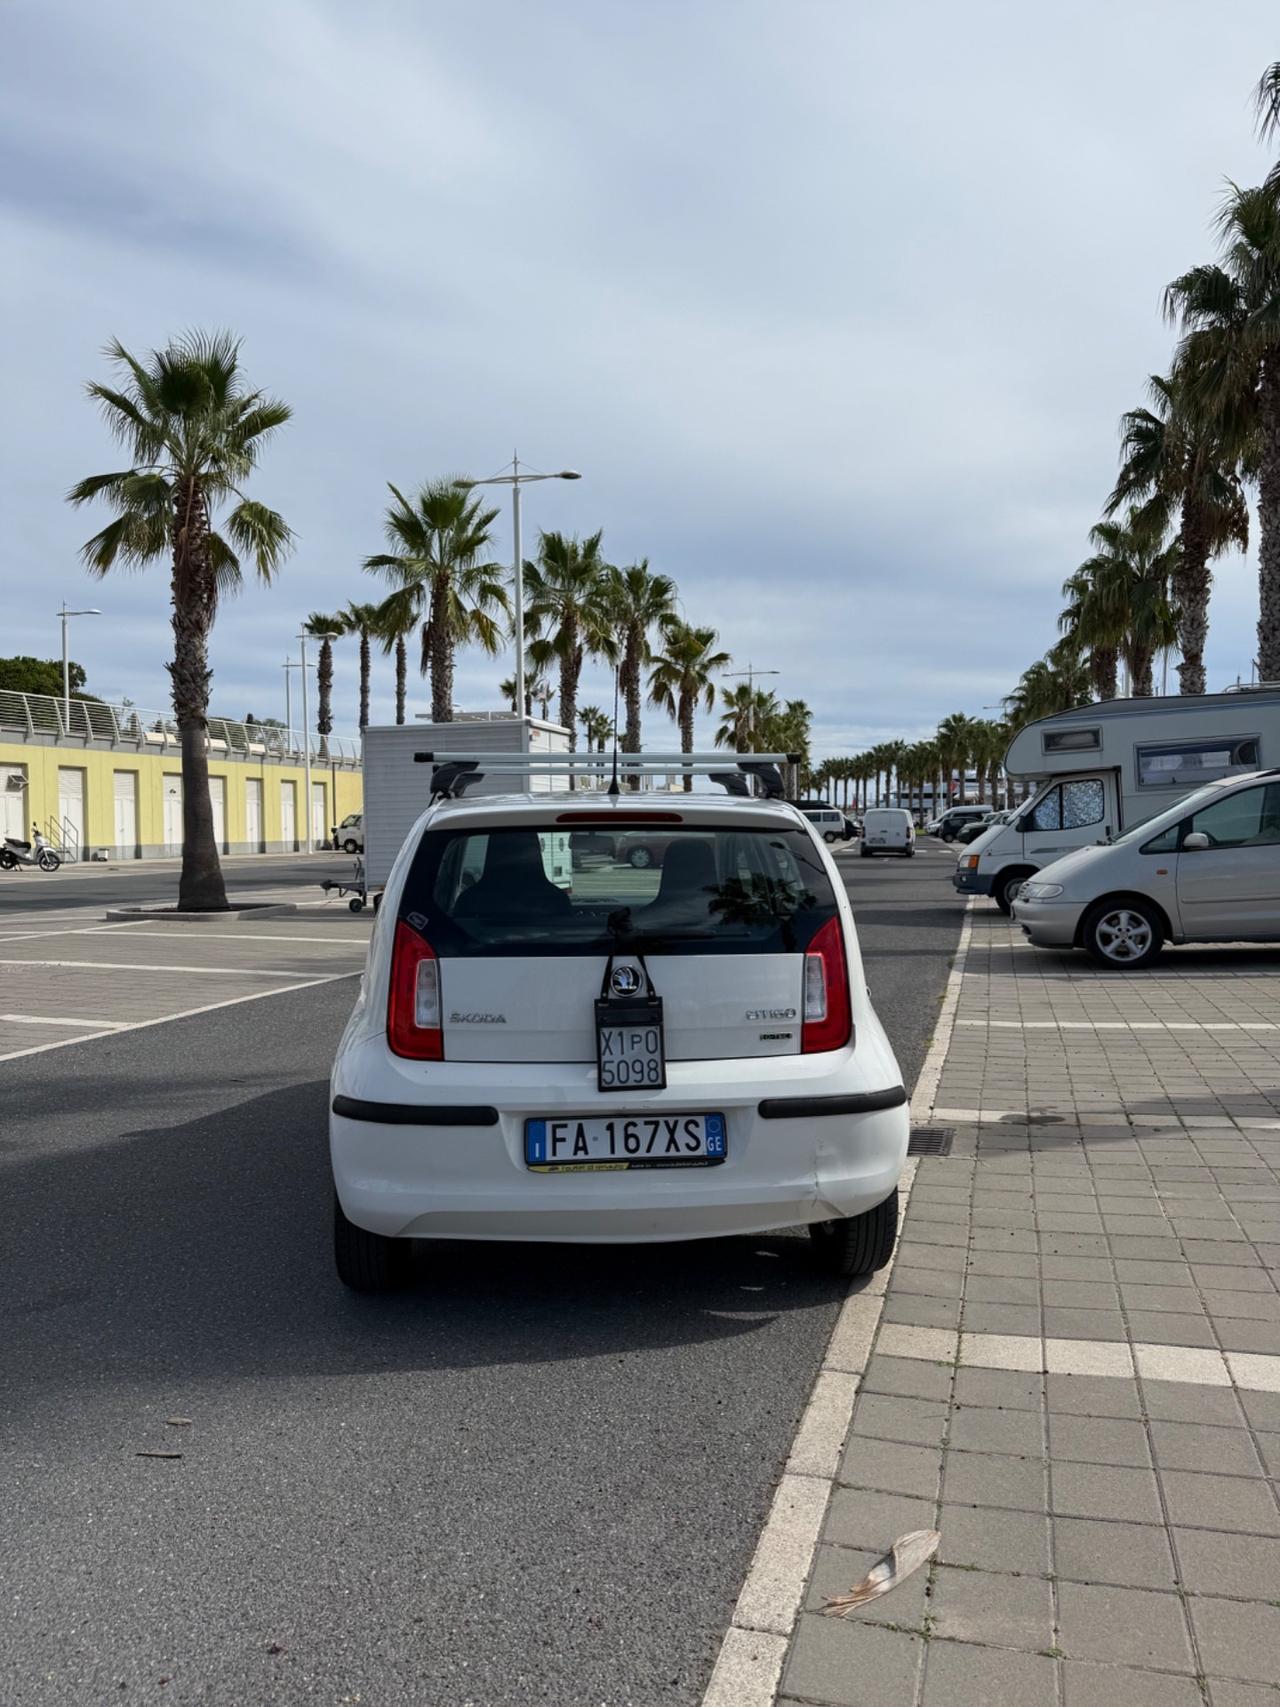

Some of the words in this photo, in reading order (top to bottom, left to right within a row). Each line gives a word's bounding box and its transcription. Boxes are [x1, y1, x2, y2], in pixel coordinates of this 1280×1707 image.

[601, 1058, 660, 1085] 5098
[551, 1122, 590, 1157] FA
[605, 1119, 702, 1155] 167XS
[707, 1137, 723, 1152] GE
